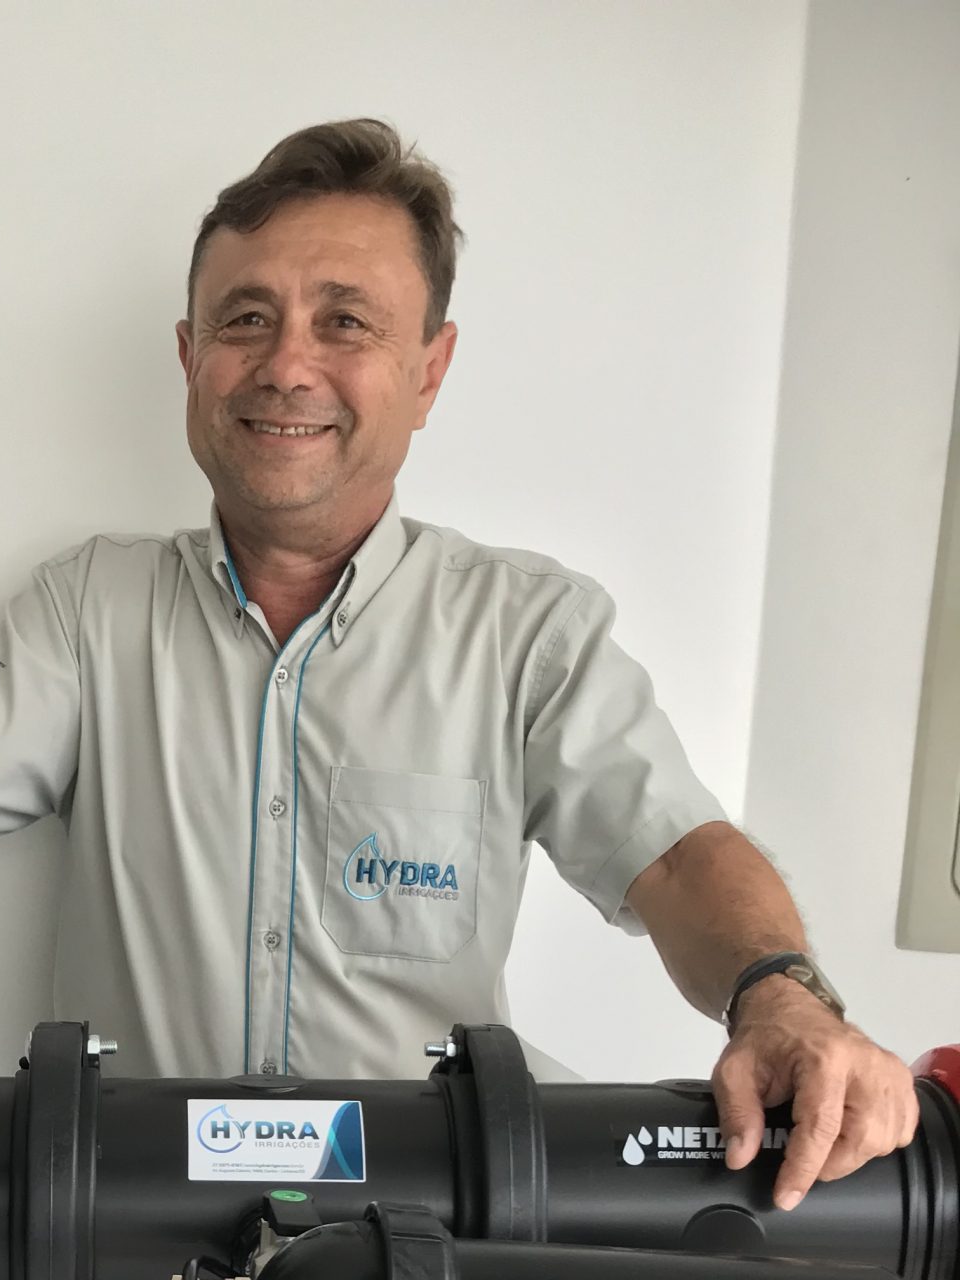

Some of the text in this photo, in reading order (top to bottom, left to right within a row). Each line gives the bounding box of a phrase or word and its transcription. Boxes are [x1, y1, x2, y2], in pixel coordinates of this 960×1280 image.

[356, 857, 458, 890] HYDRA
[210, 1120, 320, 1140] HYDRA
[254, 1139, 320, 1149] IRRIGAÇÕES
[658, 1151, 684, 1159] GROW
[685, 1151, 711, 1159] MORE
